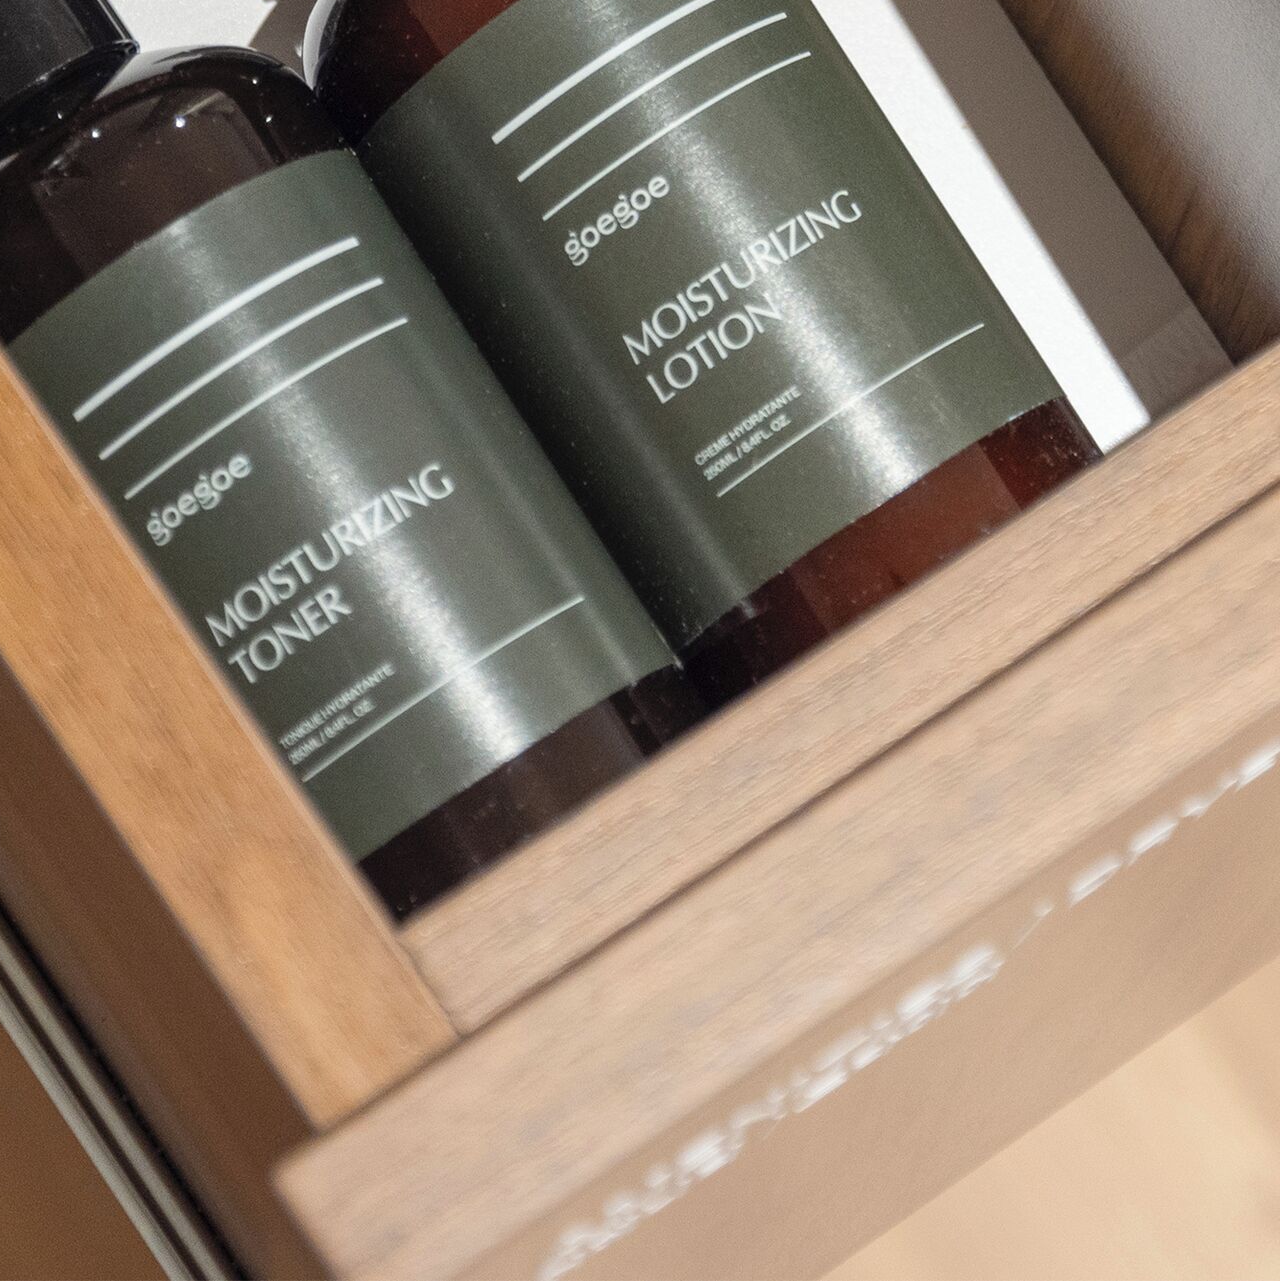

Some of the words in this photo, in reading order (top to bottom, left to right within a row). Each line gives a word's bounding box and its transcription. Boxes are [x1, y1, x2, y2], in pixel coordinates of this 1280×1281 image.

[564, 175, 670, 266] goegoe
[622, 190, 862, 365] MOISTURIZING
[646, 292, 782, 404] LOTION
[728, 385, 801, 441] HYDRATANTE
[146, 454, 252, 546] goegoe
[205, 462, 455, 647] MOISTURIZING
[228, 585, 352, 684] TONER
[319, 662, 396, 720] HYDRATANTE
